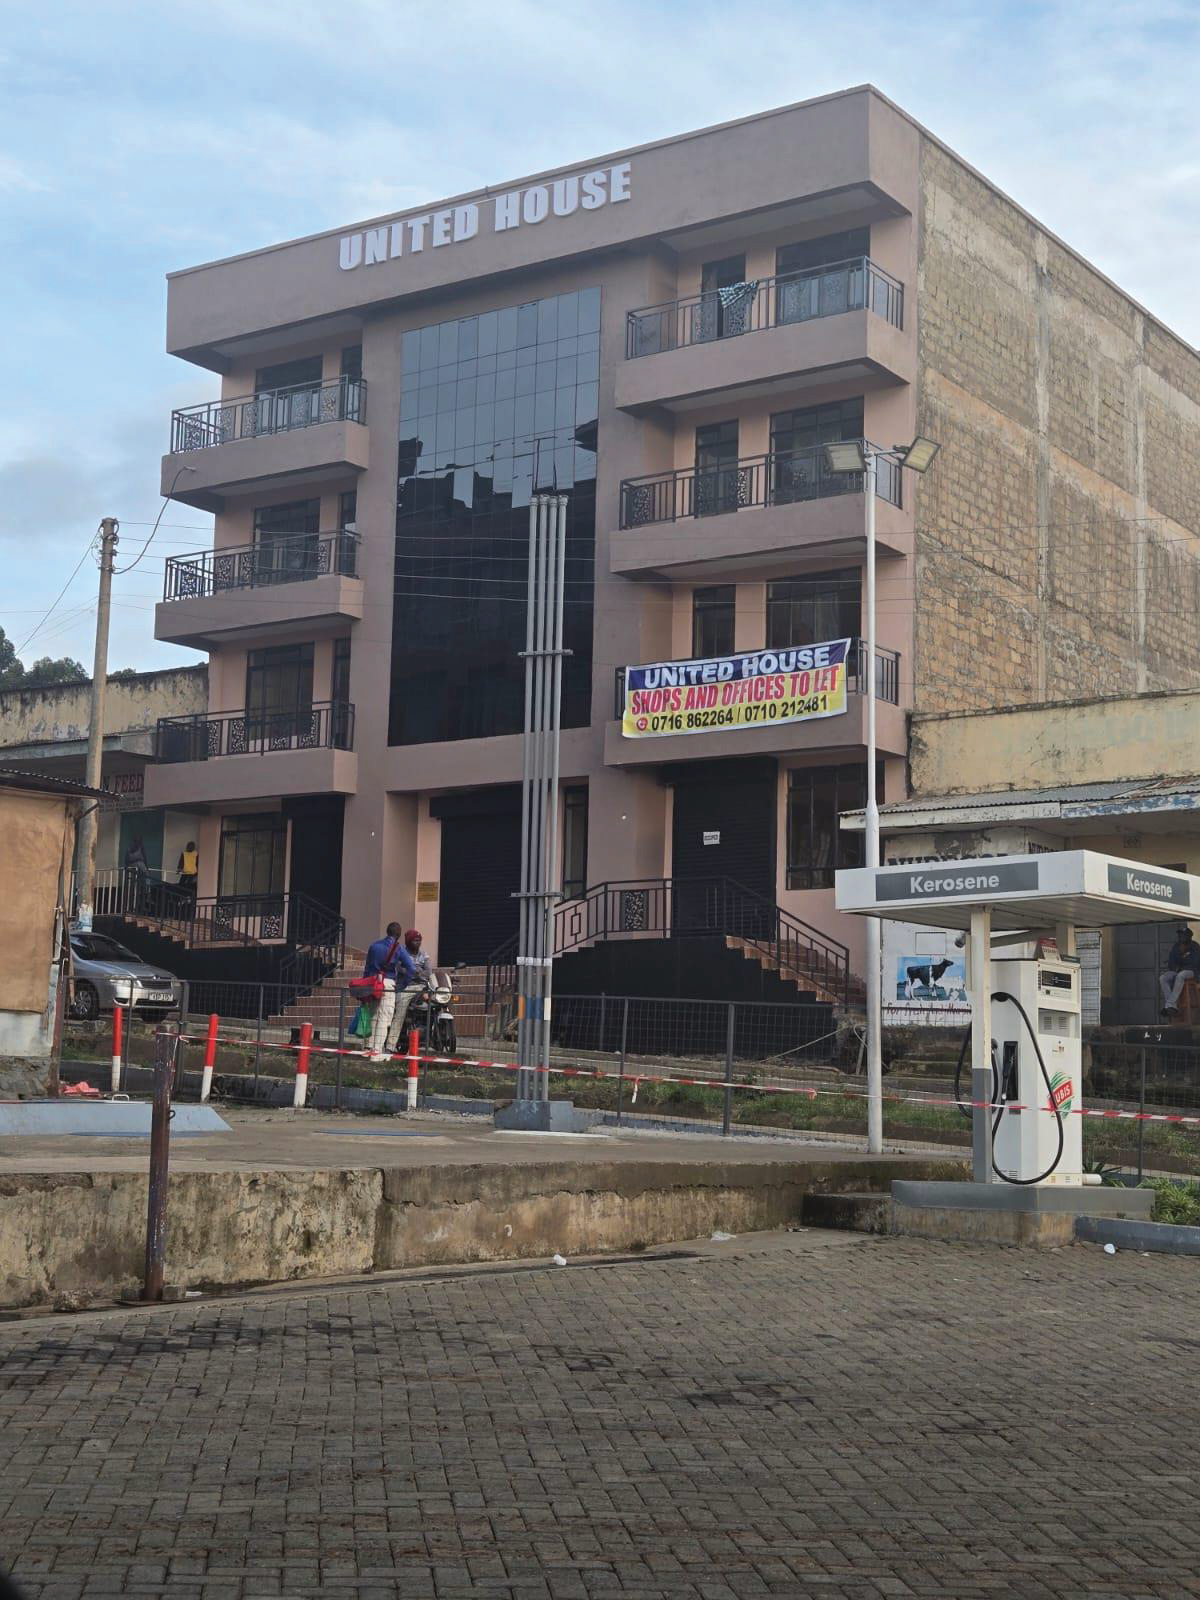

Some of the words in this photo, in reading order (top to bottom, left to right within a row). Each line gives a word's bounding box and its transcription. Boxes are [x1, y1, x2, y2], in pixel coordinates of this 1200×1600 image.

[339, 203, 479, 271] UNITED
[494, 162, 632, 233] HOUSE
[644, 661, 734, 689] UNITED
[742, 646, 831, 676] HOUSE
[631, 688, 682, 715] SHOPS
[684, 685, 719, 710] AND
[721, 674, 788, 706] OFFICES
[789, 672, 810, 697] TO
[813, 665, 840, 692] LET
[651, 714, 682, 731] 0716
[686, 707, 734, 729] 862264
[744, 702, 776, 722] 0710
[780, 694, 828, 718] 212481
[910, 872, 1000, 894] Kerosene
[1126, 871, 1173, 898] Kerosene
[1052, 1085, 1071, 1104] UBIS
